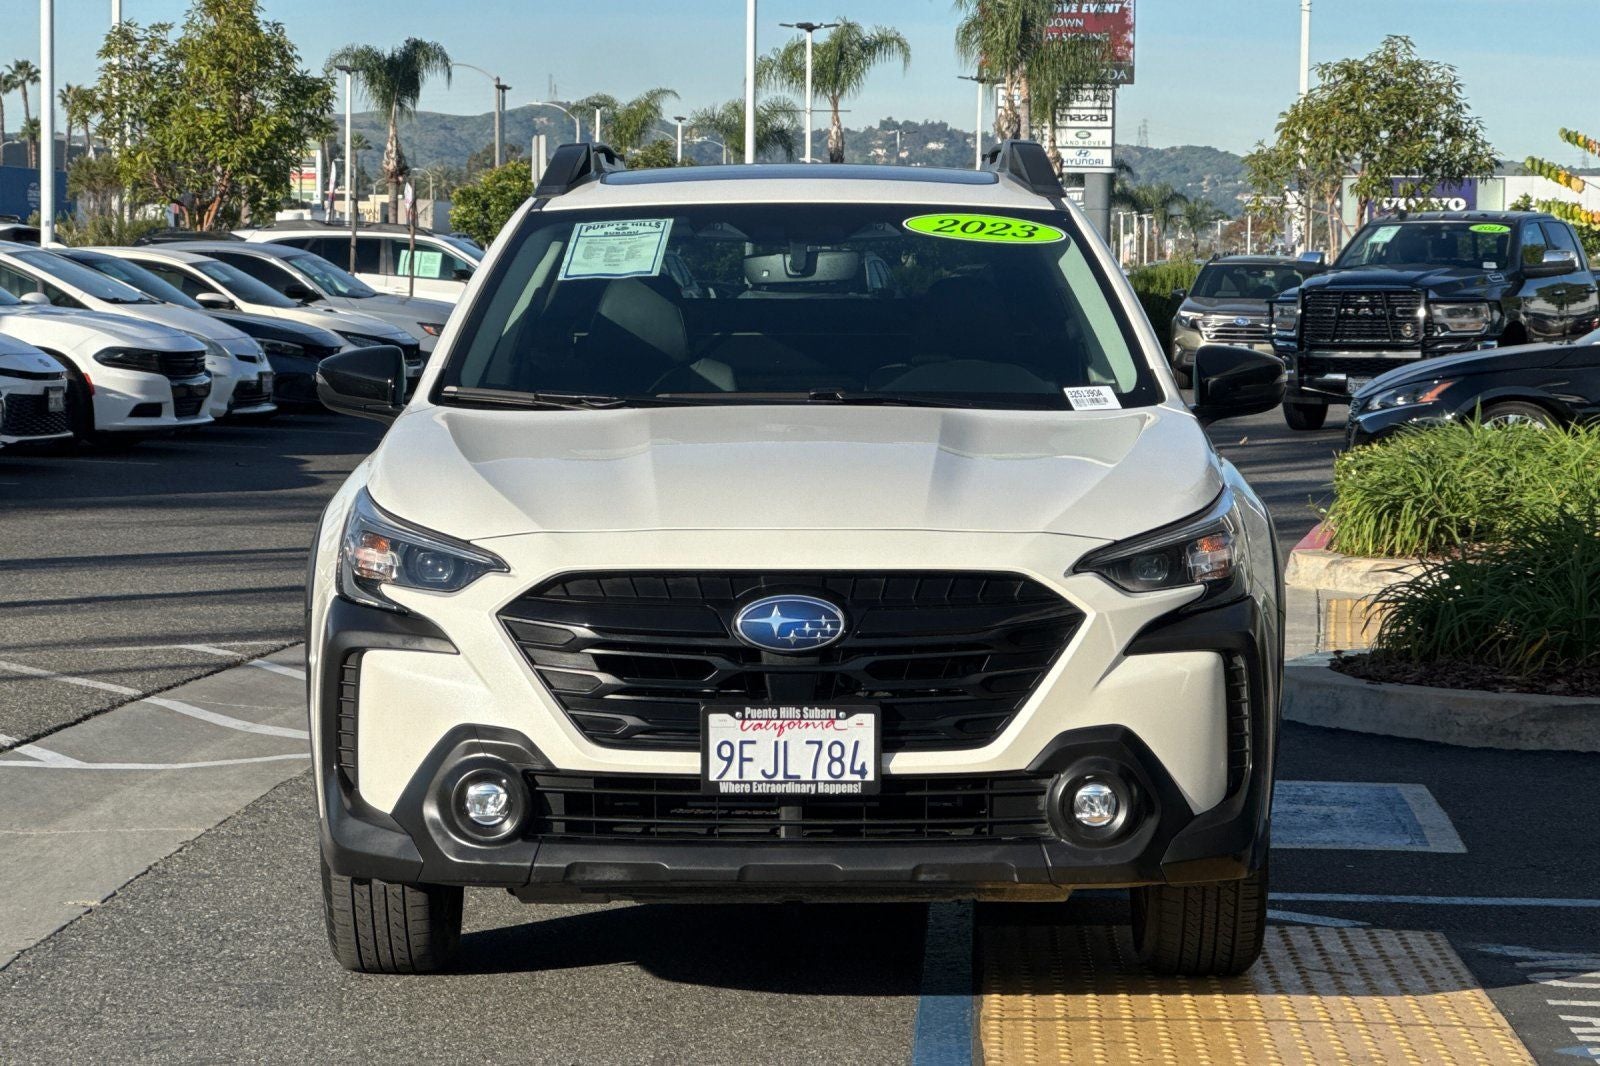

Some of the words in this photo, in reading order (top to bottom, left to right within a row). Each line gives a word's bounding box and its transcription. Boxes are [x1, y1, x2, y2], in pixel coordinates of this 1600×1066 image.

[1081, 3, 1121, 13] EVENT
[1047, 18, 1084, 27] DOWN
[1047, 32, 1059, 40] AT
[1066, 94, 1111, 102] UBARU
[585, 222, 627, 232] PUENTE
[630, 221, 661, 229] HILLS
[932, 218, 1039, 238] 2023
[744, 706, 778, 719] Puente
[779, 706, 801, 719] Hills
[802, 706, 837, 719] Subaru
[740, 718, 848, 737] California
[715, 740, 868, 779] 9FJL784
[719, 782, 750, 793] Where
[752, 782, 816, 794] Extraordinary
[817, 782, 862, 794] Happens!
